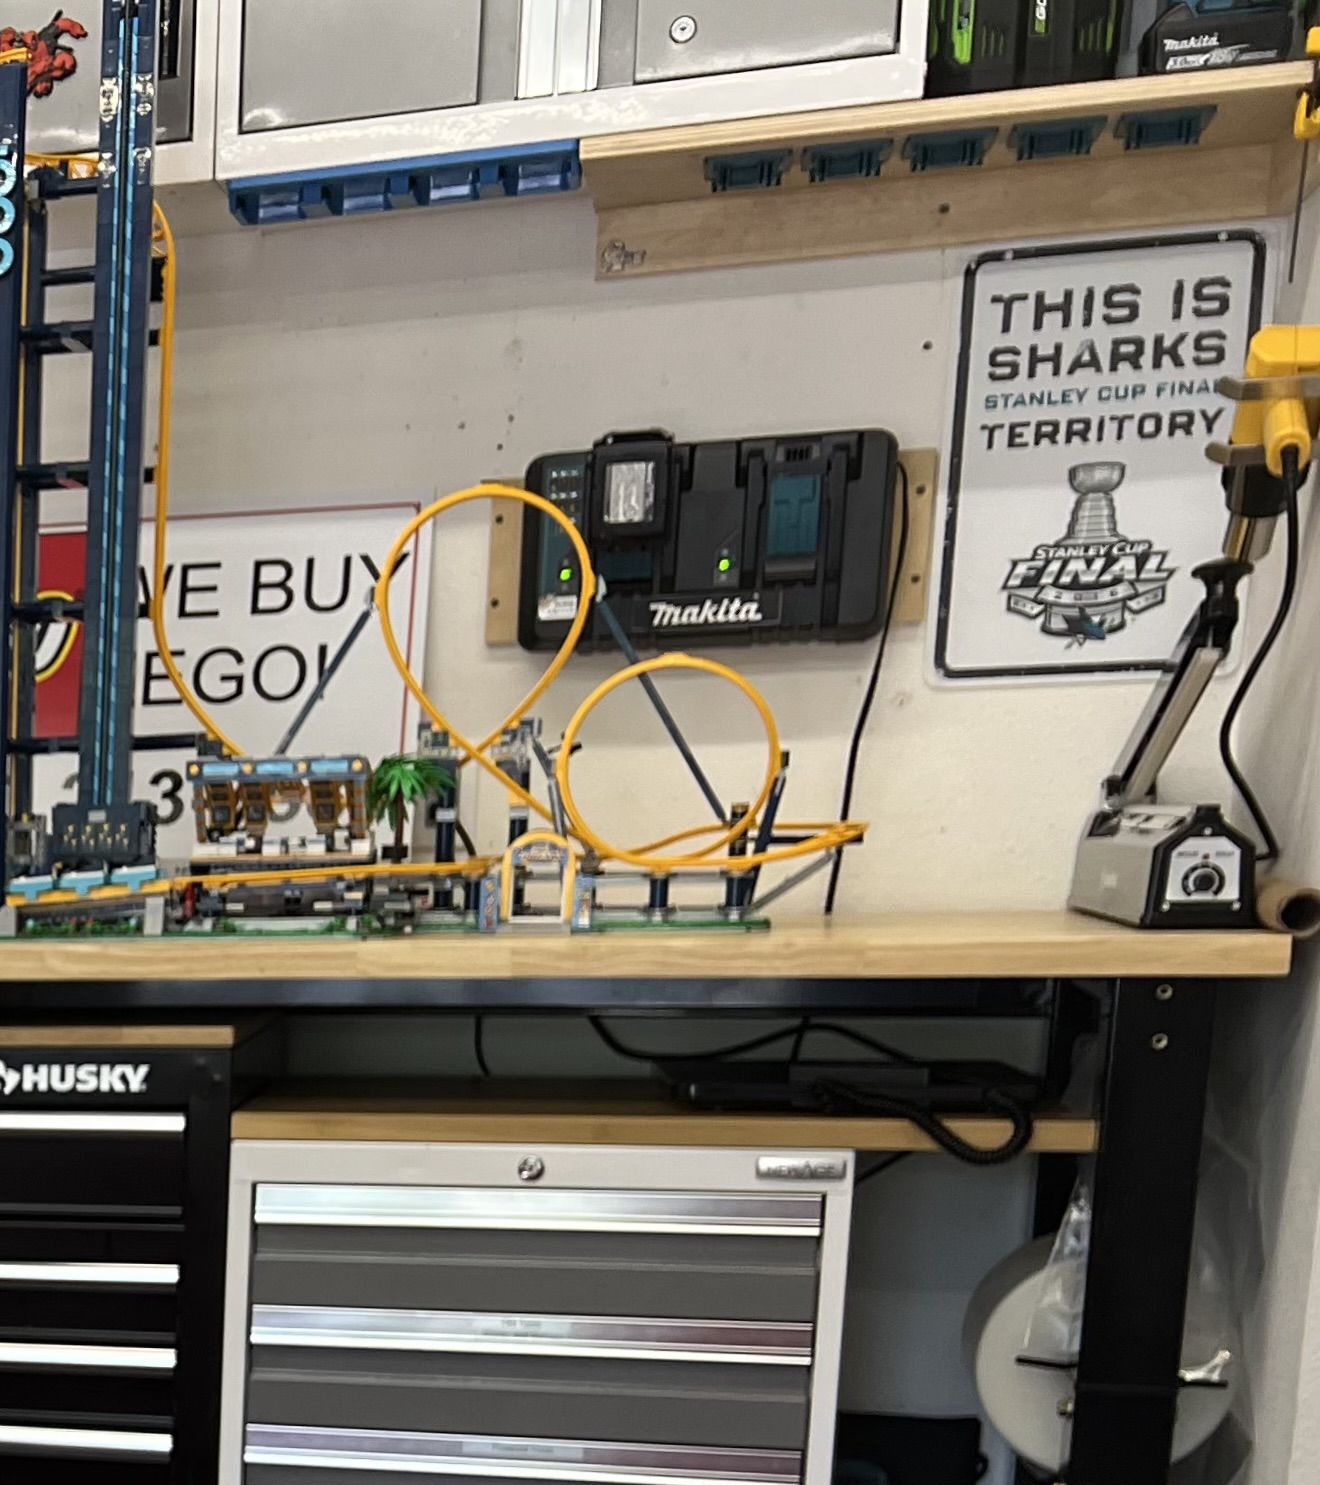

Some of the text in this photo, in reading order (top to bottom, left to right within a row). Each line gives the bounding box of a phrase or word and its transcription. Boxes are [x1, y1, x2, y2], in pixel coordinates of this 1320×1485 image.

[1163, 32, 1220, 51] makita
[991, 276, 1232, 333] THIS IS
[987, 329, 1227, 381] SHARKS
[984, 387, 1090, 410] STANLEY
[1097, 383, 1146, 402] CUP
[980, 407, 1225, 450] TERRITORY
[1005, 550, 1175, 588] FINAL
[1034, 541, 1150, 561] STANLEY CUP
[250, 551, 411, 616] BUY
[649, 592, 763, 628] makita
[141, 642, 330, 707] EGO!
[21, 1062, 151, 1095] HUSKY
